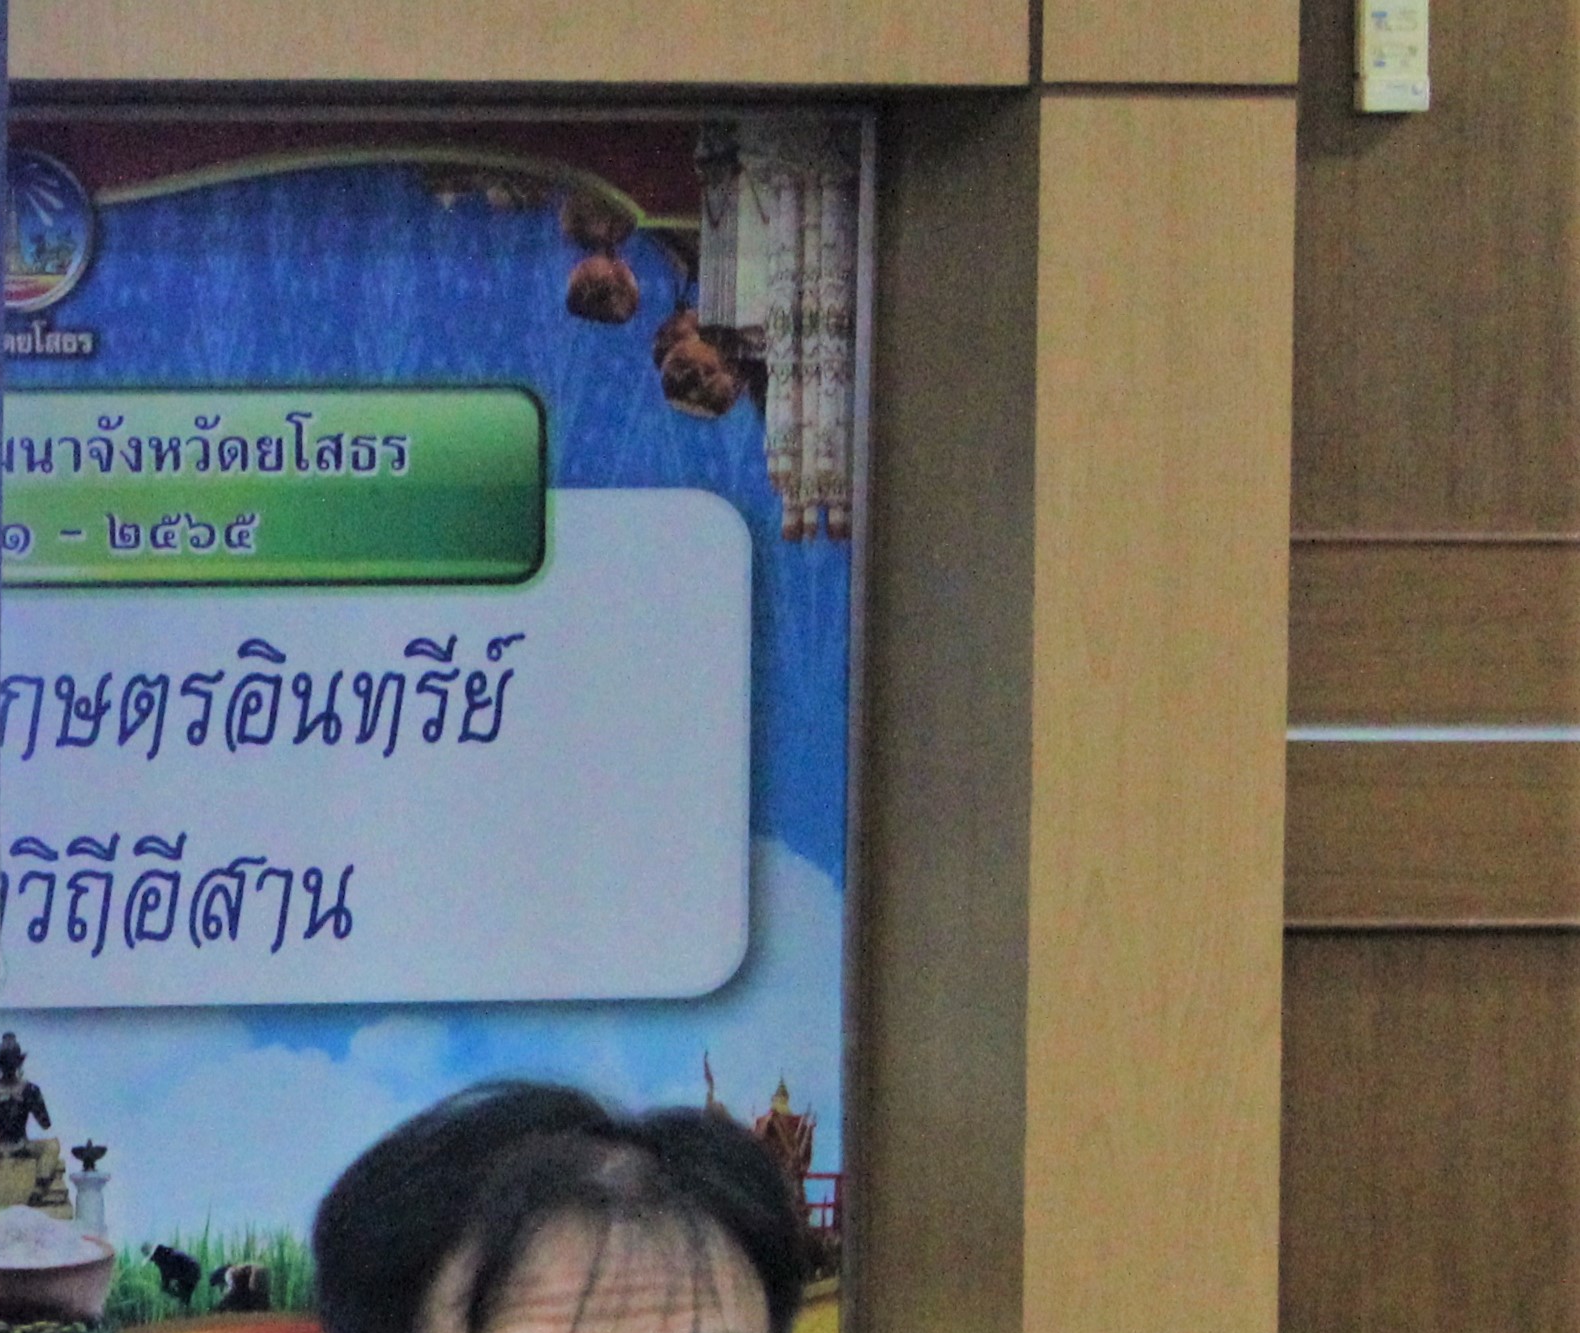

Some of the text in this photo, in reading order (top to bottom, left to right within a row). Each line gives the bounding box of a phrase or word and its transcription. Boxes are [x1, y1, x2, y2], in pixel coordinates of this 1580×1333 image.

[3, 320, 93, 354] ดยโสธร
[0, 632, 527, 760] กษตรอินทรีย์
